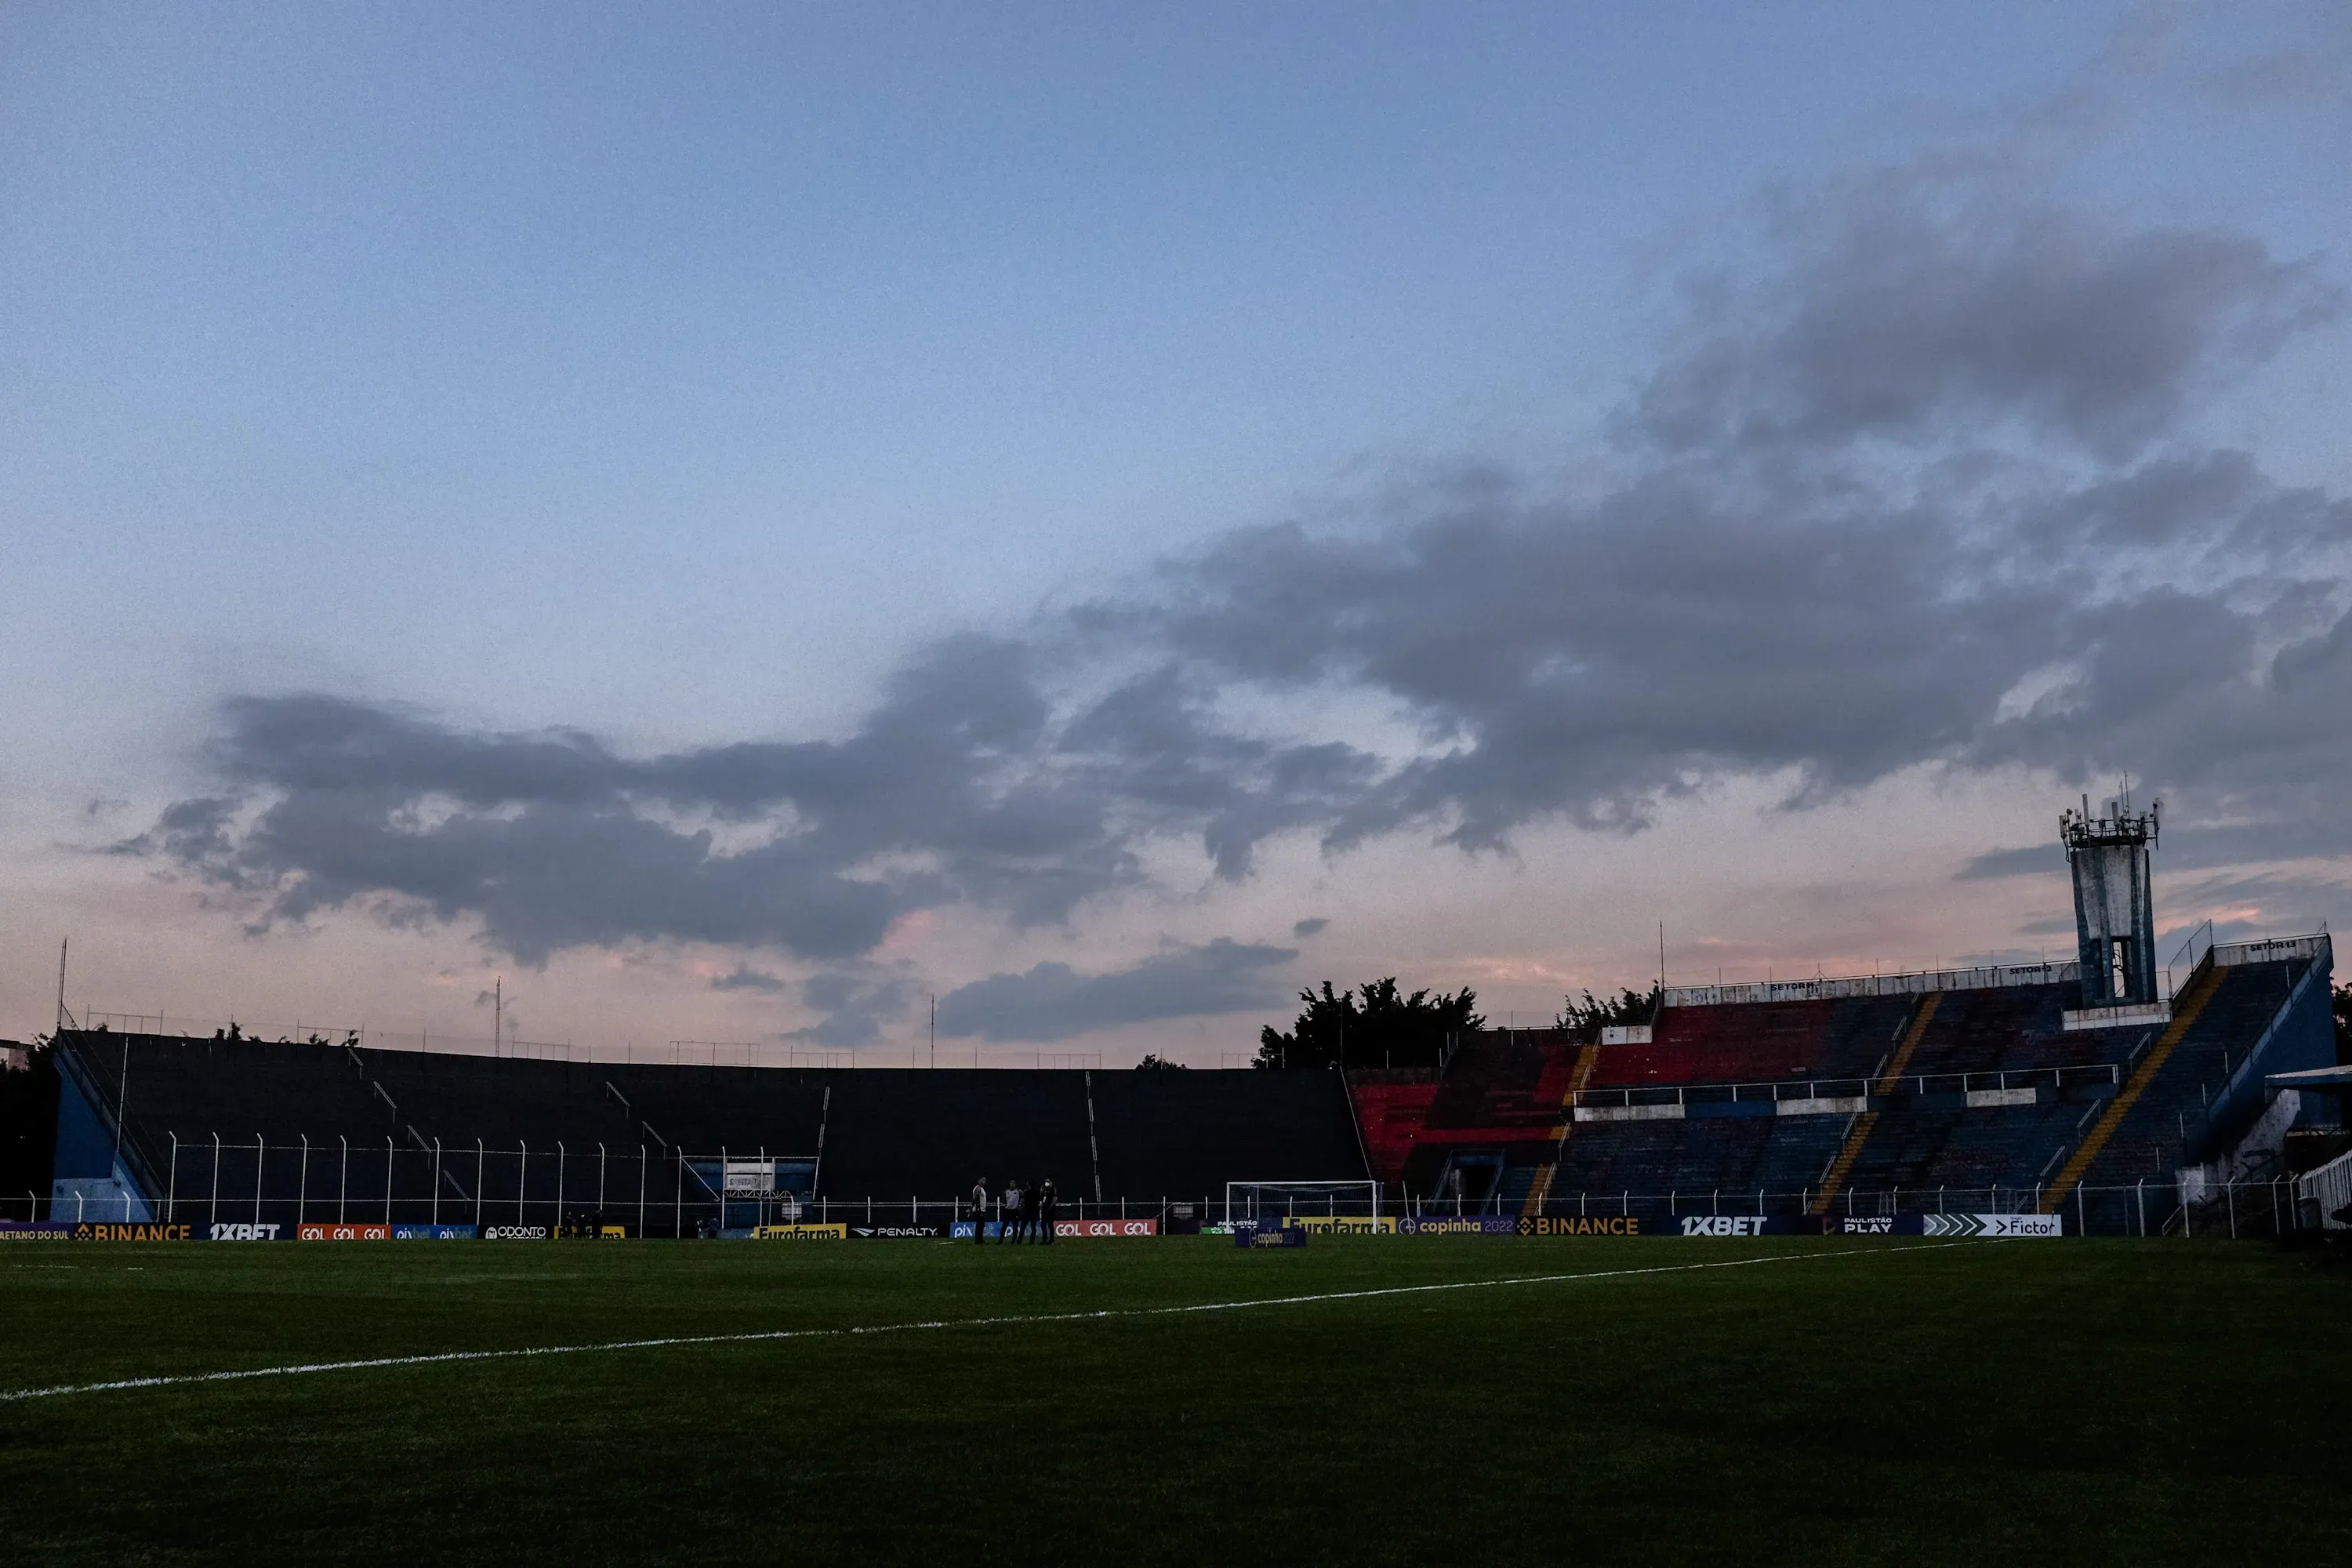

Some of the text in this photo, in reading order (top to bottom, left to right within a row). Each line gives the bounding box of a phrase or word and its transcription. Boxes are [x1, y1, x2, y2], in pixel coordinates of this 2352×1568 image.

[2249, 942, 2284, 951] SETOR
[2009, 966, 2041, 975] SETOR
[1770, 982, 1805, 991] SETOR
[209, 1223, 281, 1240] 1XBET
[498, 1226, 546, 1236] ODONTO
[1055, 1224, 1082, 1236] GOL
[1089, 1223, 1116, 1236] GOL
[1123, 1222, 1152, 1235] GOL
[1419, 1218, 1513, 1236] copinha 2022
[1537, 1217, 1639, 1235] BINANCE
[1681, 1216, 1768, 1236] 1XBET
[1844, 1224, 1893, 1233] PLAY
[2010, 1221, 2055, 1234] Fictor
[37, 1230, 52, 1240] DO
[53, 1230, 69, 1240] SUL
[95, 1225, 191, 1240] BINANCE
[301, 1228, 325, 1240] GOL
[332, 1228, 358, 1240] GOL
[759, 1227, 840, 1239] Eurofarma
[1257, 1229, 1283, 1248] copinha
